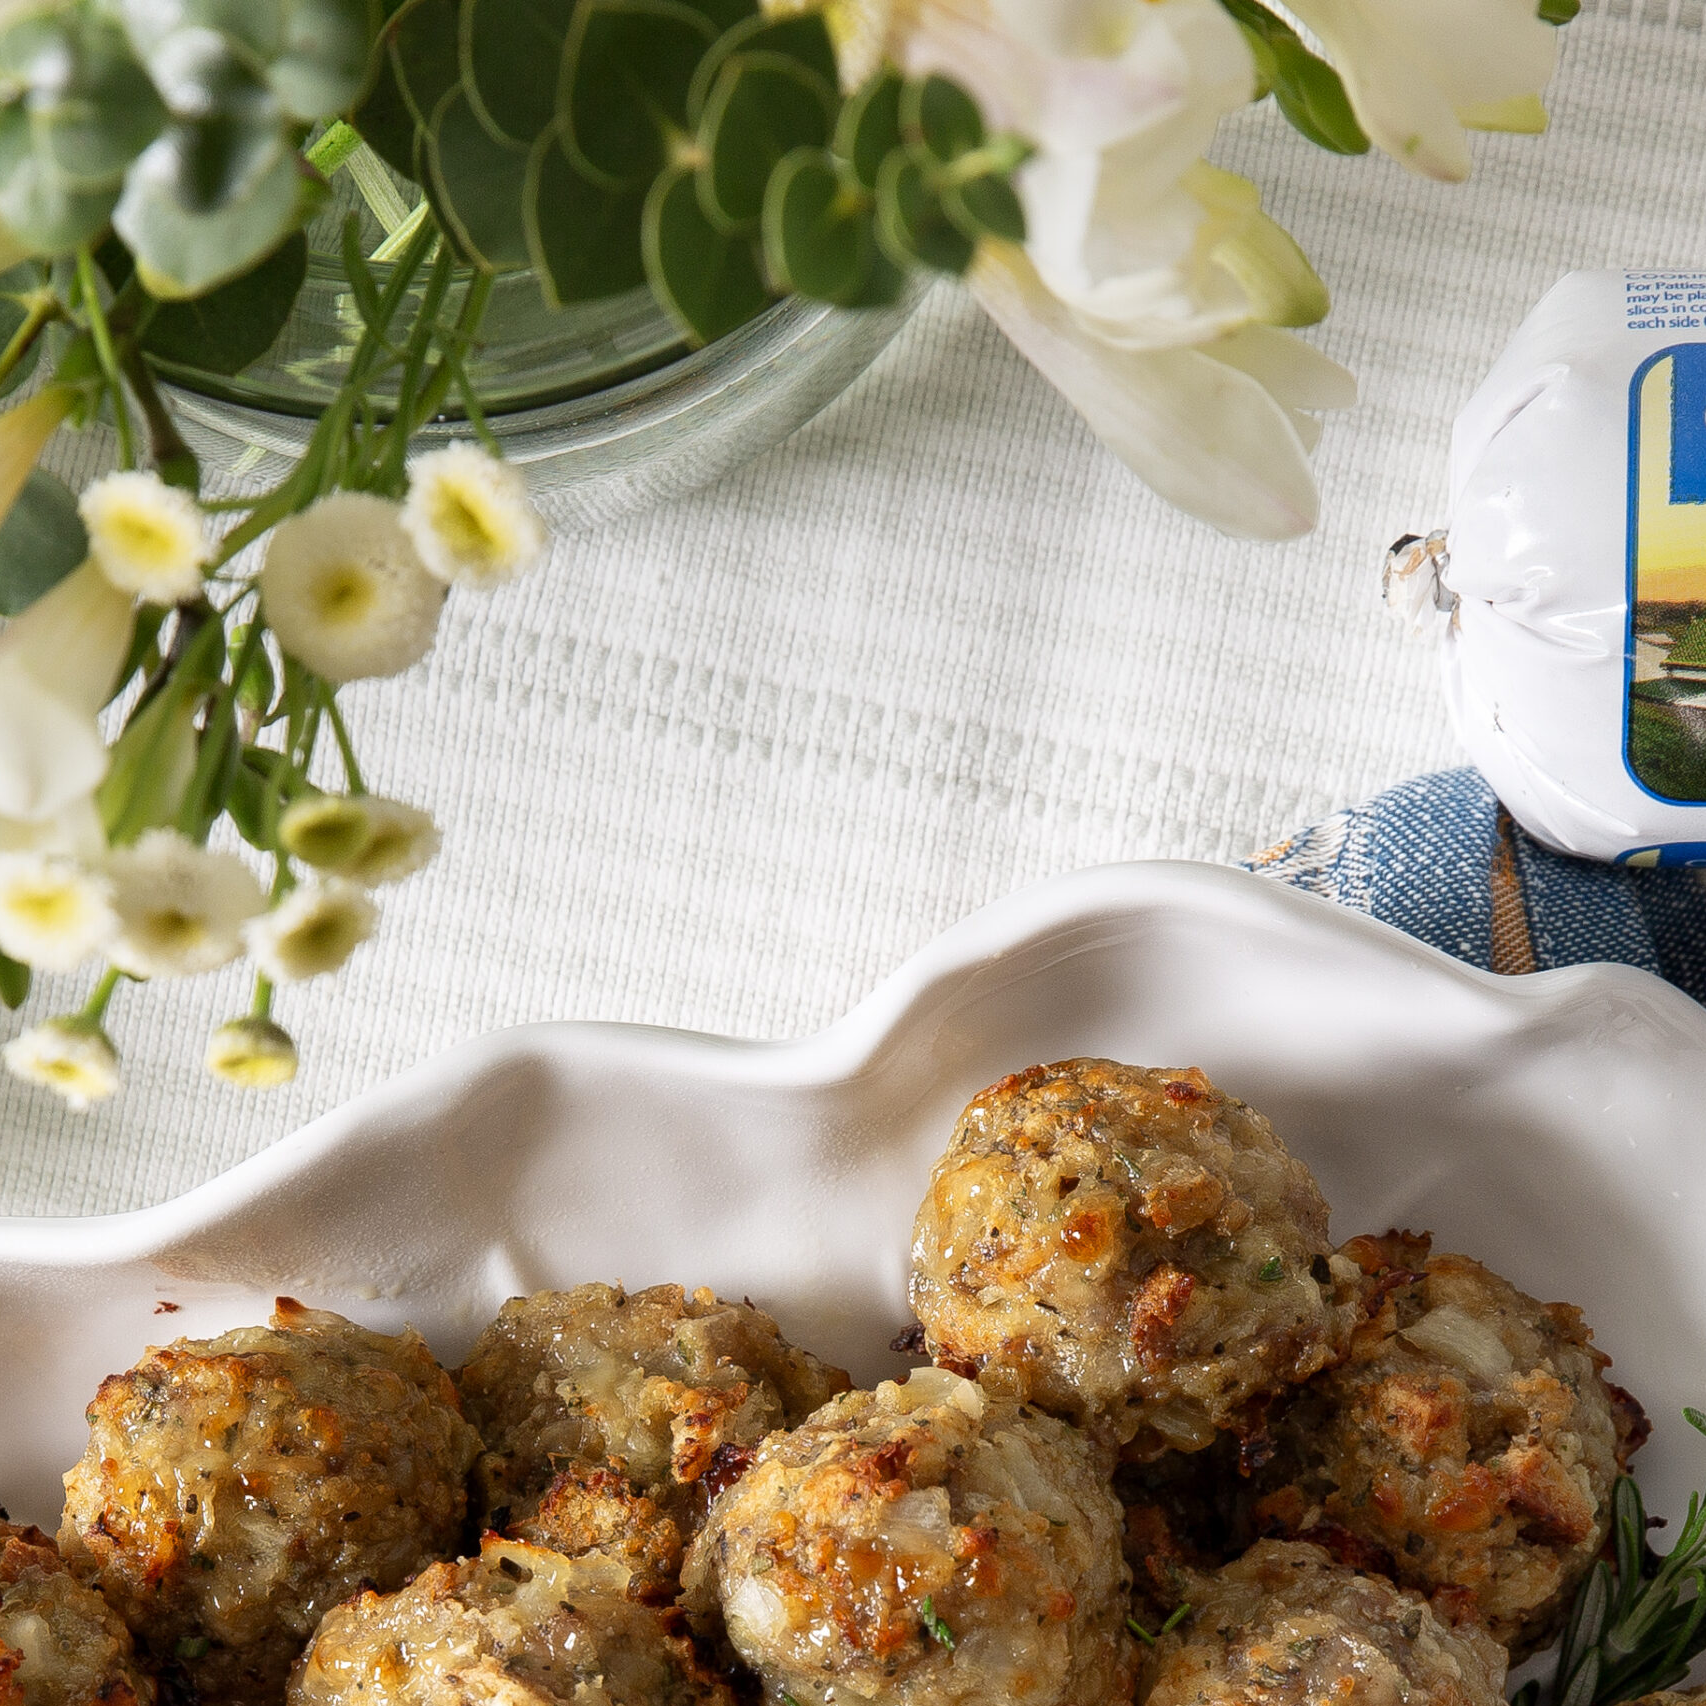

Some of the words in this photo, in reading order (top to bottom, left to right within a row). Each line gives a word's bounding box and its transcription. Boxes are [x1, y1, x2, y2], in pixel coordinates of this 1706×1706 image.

[1626, 282, 1651, 291] For
[1626, 292, 1660, 303] may
[1664, 291, 1683, 301] be
[1627, 302, 1669, 316] slices
[1672, 302, 1686, 313] in
[1627, 316, 1666, 330] each
[1669, 315, 1700, 328] side
